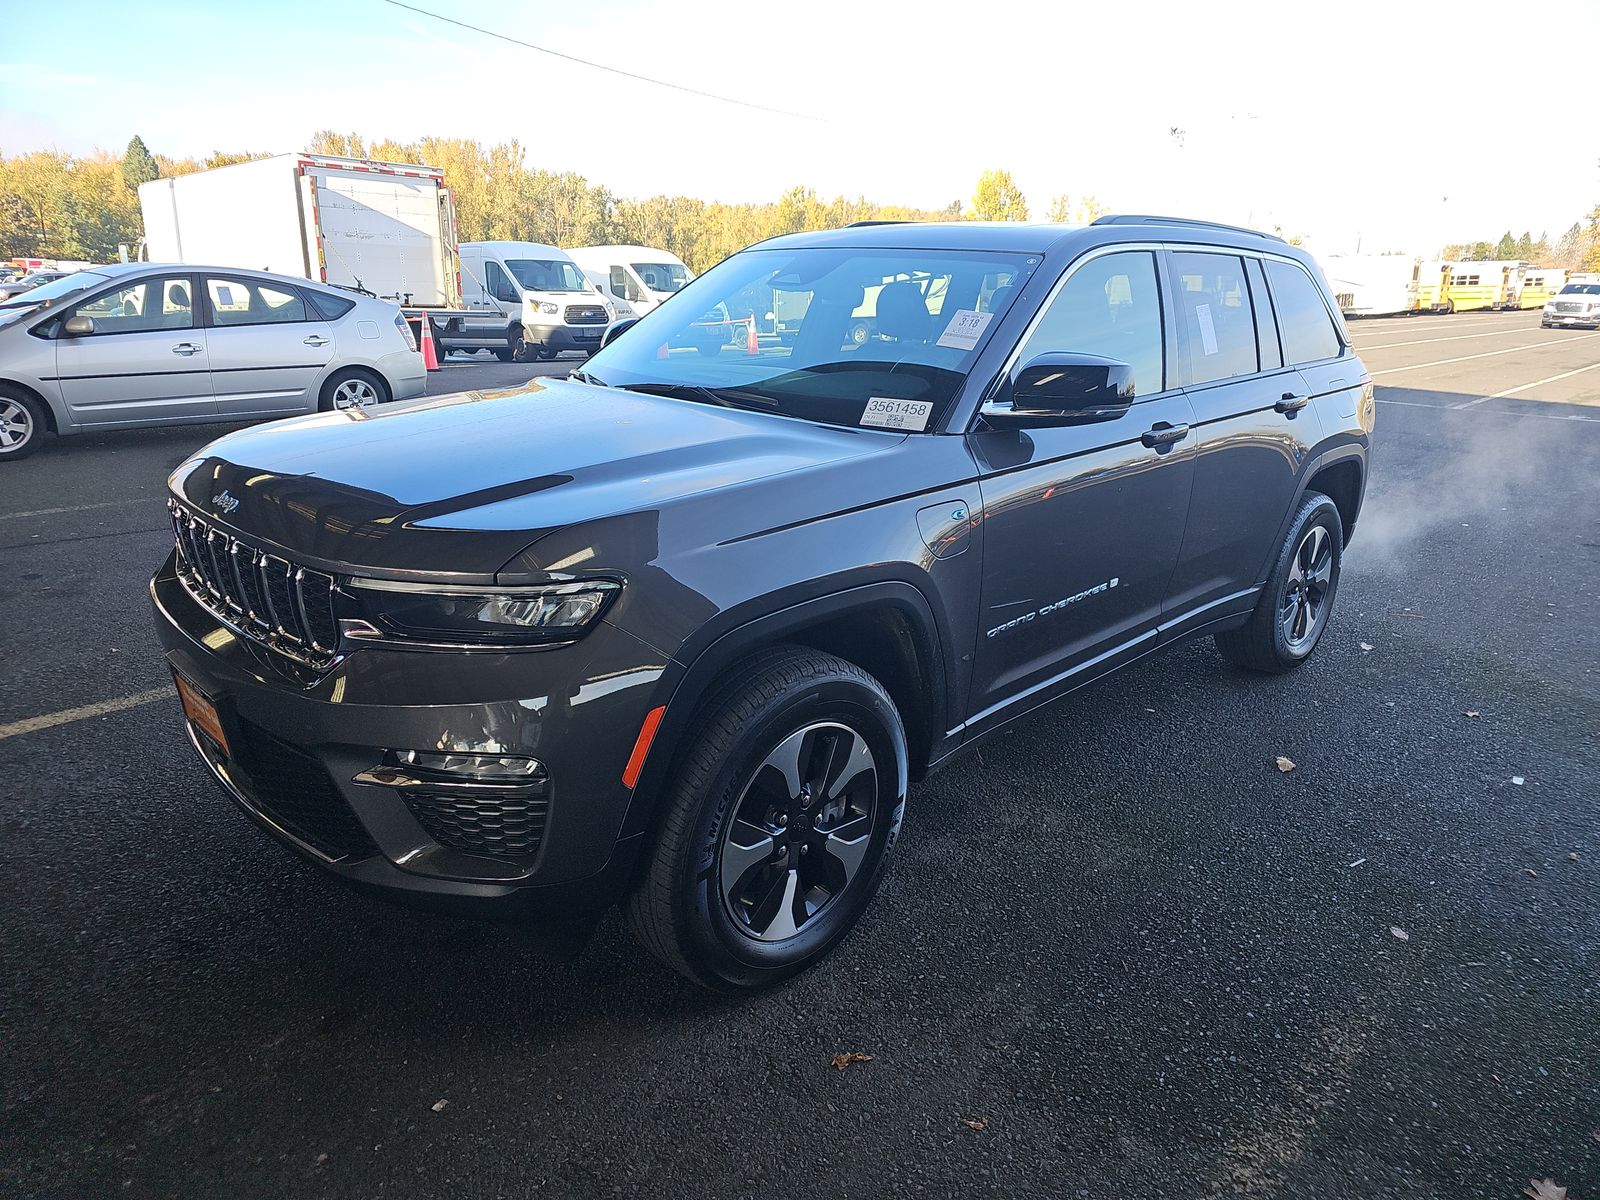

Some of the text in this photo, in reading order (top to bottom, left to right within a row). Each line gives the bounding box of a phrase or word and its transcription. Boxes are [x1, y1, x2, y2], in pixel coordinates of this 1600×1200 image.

[869, 400, 927, 416] 3561458
[212, 490, 239, 513] Jeep
[987, 582, 1108, 638] GRAND CHEROKEE
